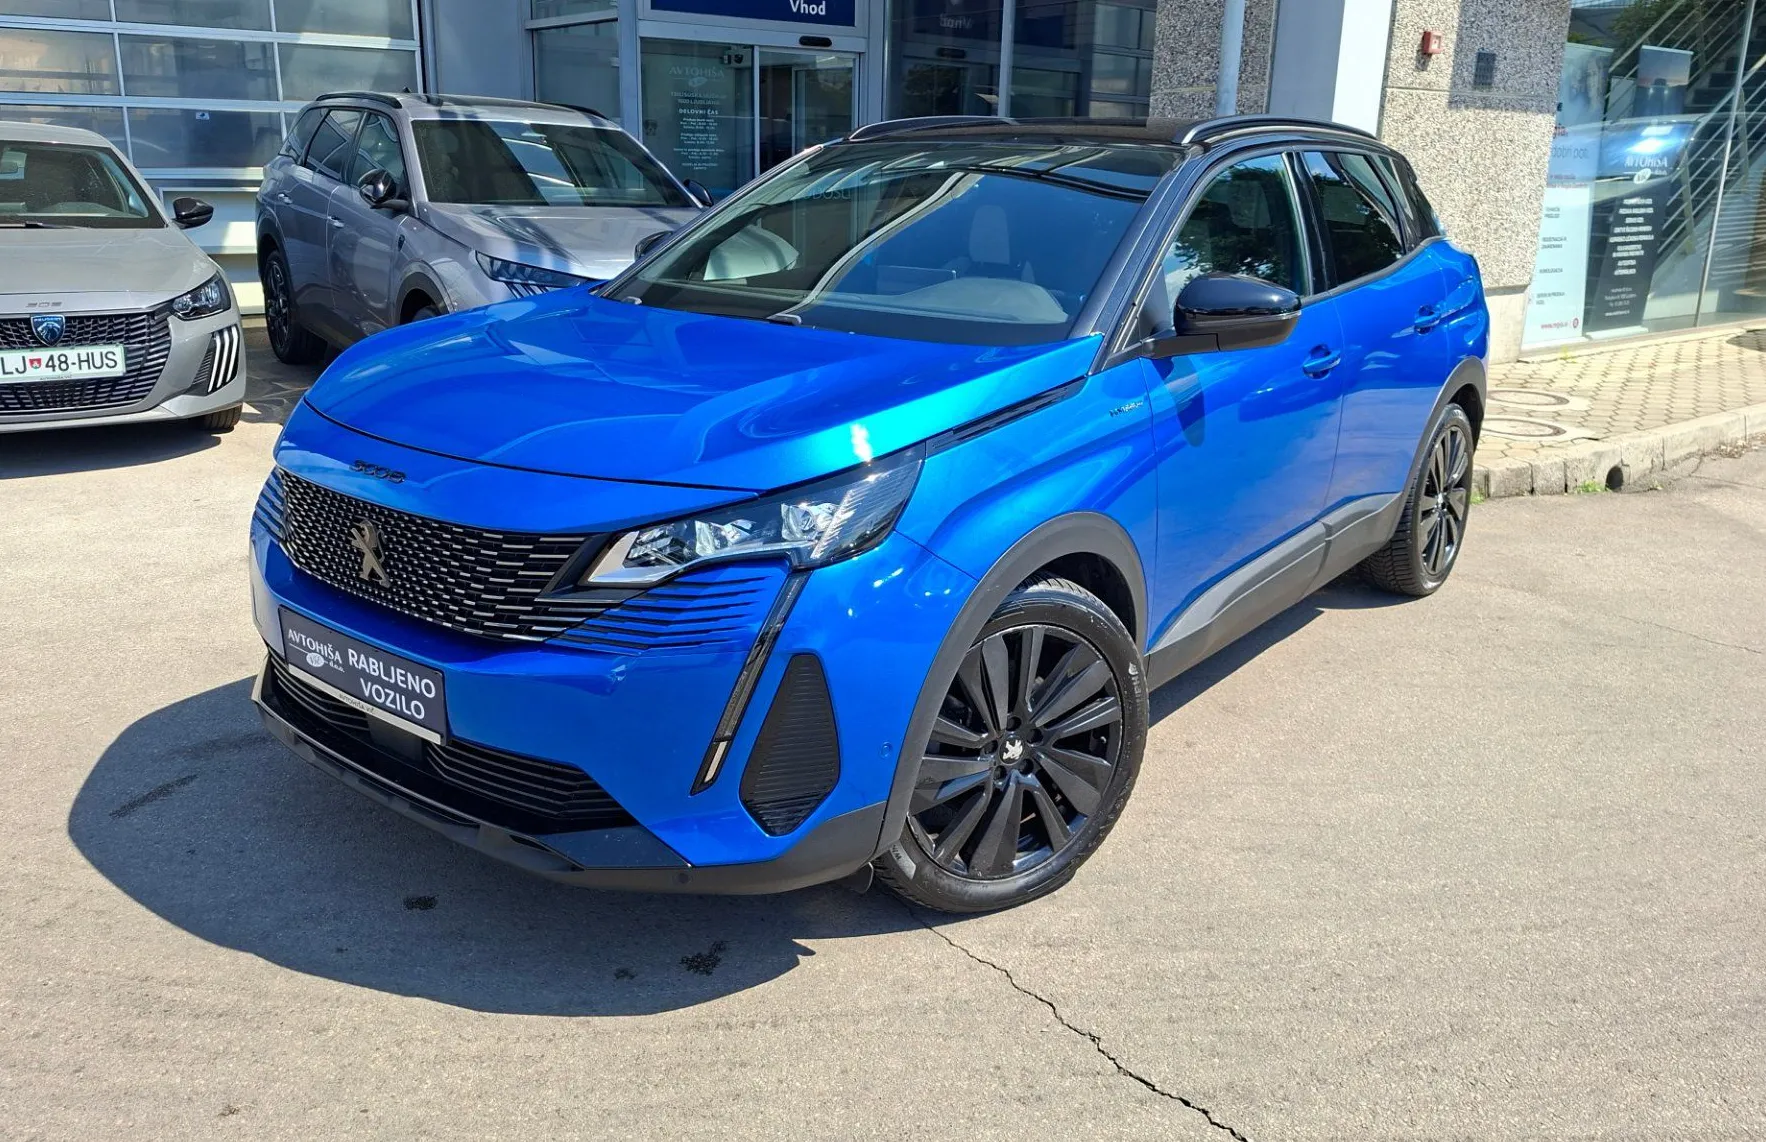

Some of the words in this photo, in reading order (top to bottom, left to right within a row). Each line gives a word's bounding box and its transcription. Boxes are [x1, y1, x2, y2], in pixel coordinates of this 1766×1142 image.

[790, 0, 826, 16] Vhod
[0, 355, 27, 375] LJ
[45, 351, 118, 372] 48-HUS
[349, 459, 406, 484] 3008
[288, 628, 343, 664] AVTOHIŠA
[348, 648, 436, 699] RABLJENO
[360, 677, 426, 720] VOZILO
